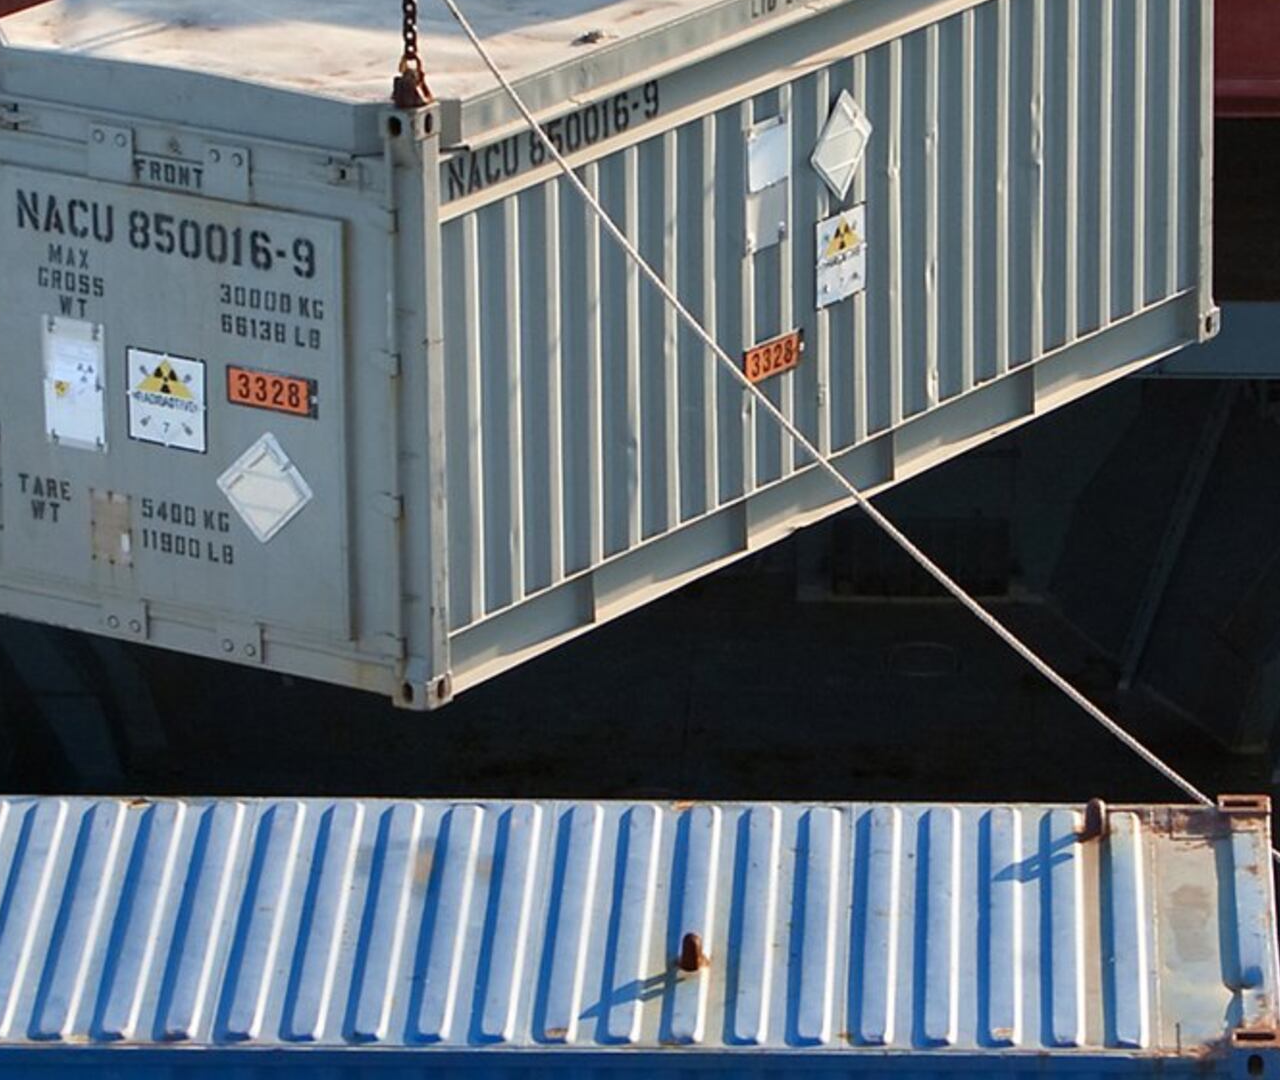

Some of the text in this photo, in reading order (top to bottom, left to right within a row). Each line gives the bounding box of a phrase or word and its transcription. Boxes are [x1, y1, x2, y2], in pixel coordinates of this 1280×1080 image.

[448, 79, 659, 200] NACU 850016-9
[134, 159, 203, 188] FRONT
[16, 188, 316, 279] NACU 850016-9
[48, 243, 89, 270] MAX
[38, 266, 104, 297] GROSS
[59, 295, 87, 318] WT
[220, 283, 324, 320] 30000 KG
[221, 313, 321, 350] 66138 LB
[751, 339, 793, 377] 3328
[237, 373, 300, 408] 3328
[18, 473, 71, 501] TARE
[31, 500, 60, 522] WT
[142, 498, 230, 532] 5400 KG
[142, 529, 234, 565] 11900 LB
